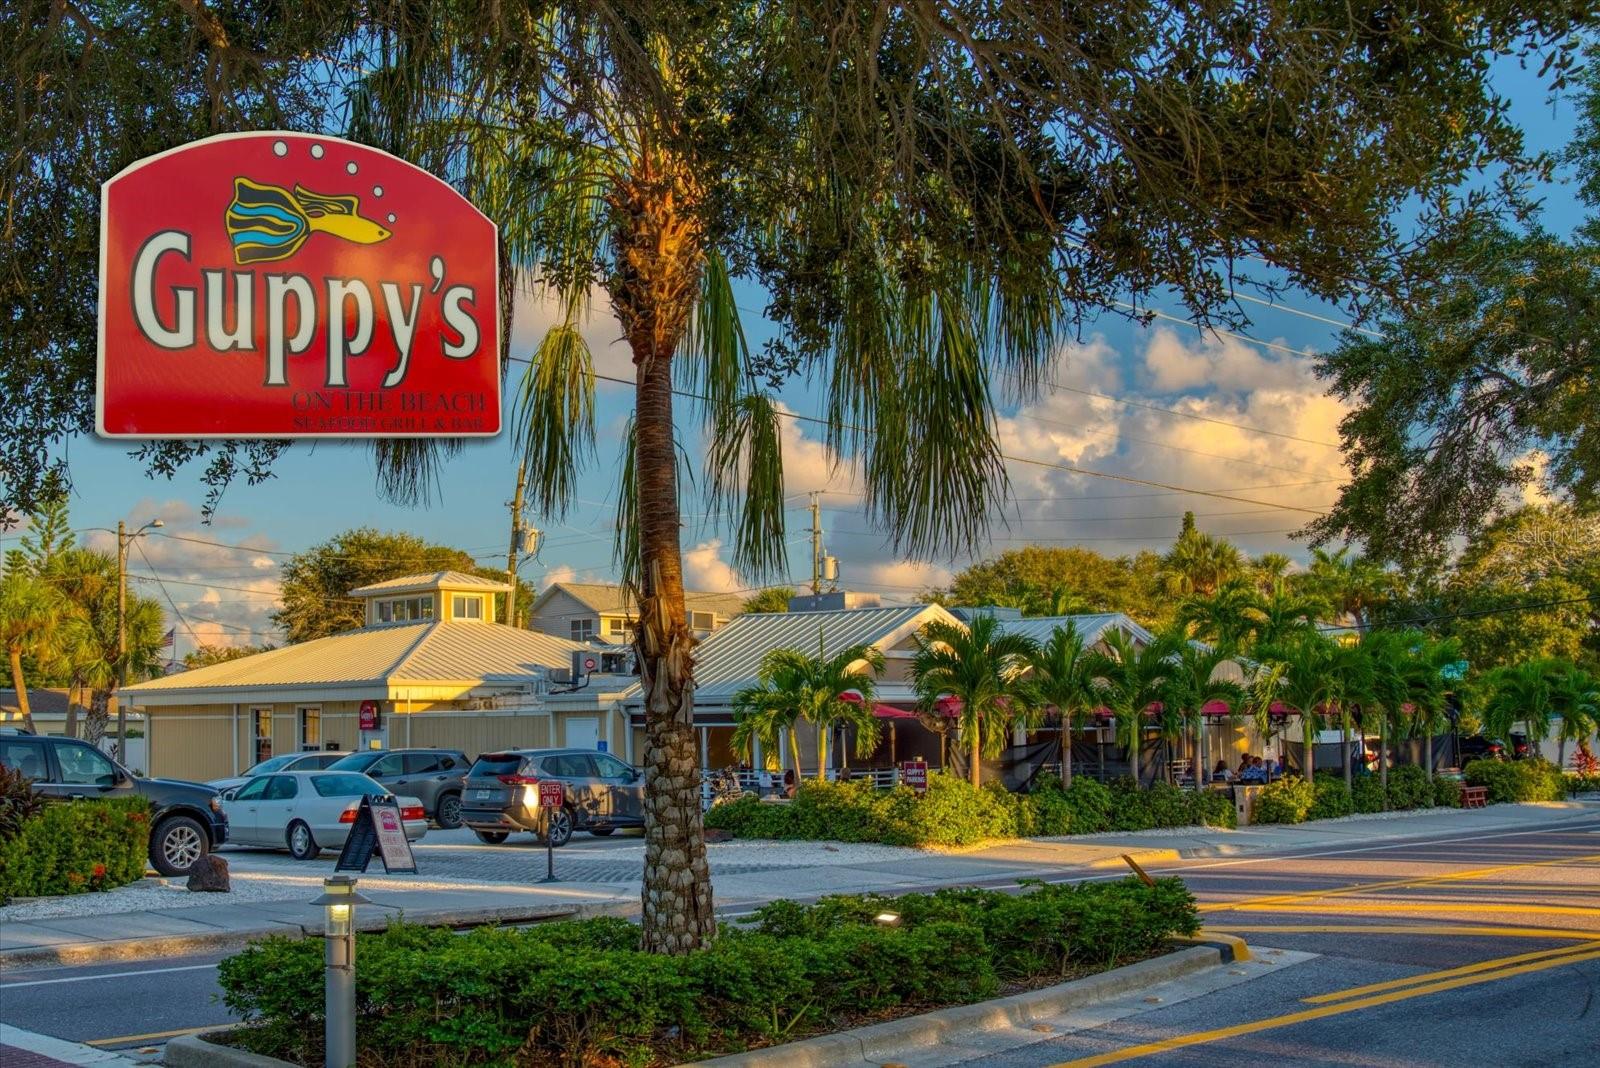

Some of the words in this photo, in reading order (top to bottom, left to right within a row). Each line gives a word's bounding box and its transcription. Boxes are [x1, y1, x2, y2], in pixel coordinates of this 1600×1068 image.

[130, 230, 482, 388] Guppy's
[291, 391, 332, 412] ON
[343, 391, 391, 412] THE
[401, 391, 485, 412] BEACH
[293, 416, 377, 430] SEAFOOD
[381, 416, 428, 430] GRILL
[435, 416, 445, 430] &
[451, 416, 482, 430] BAR
[541, 784, 561, 794] ENTER
[542, 795, 559, 805] ONLY
